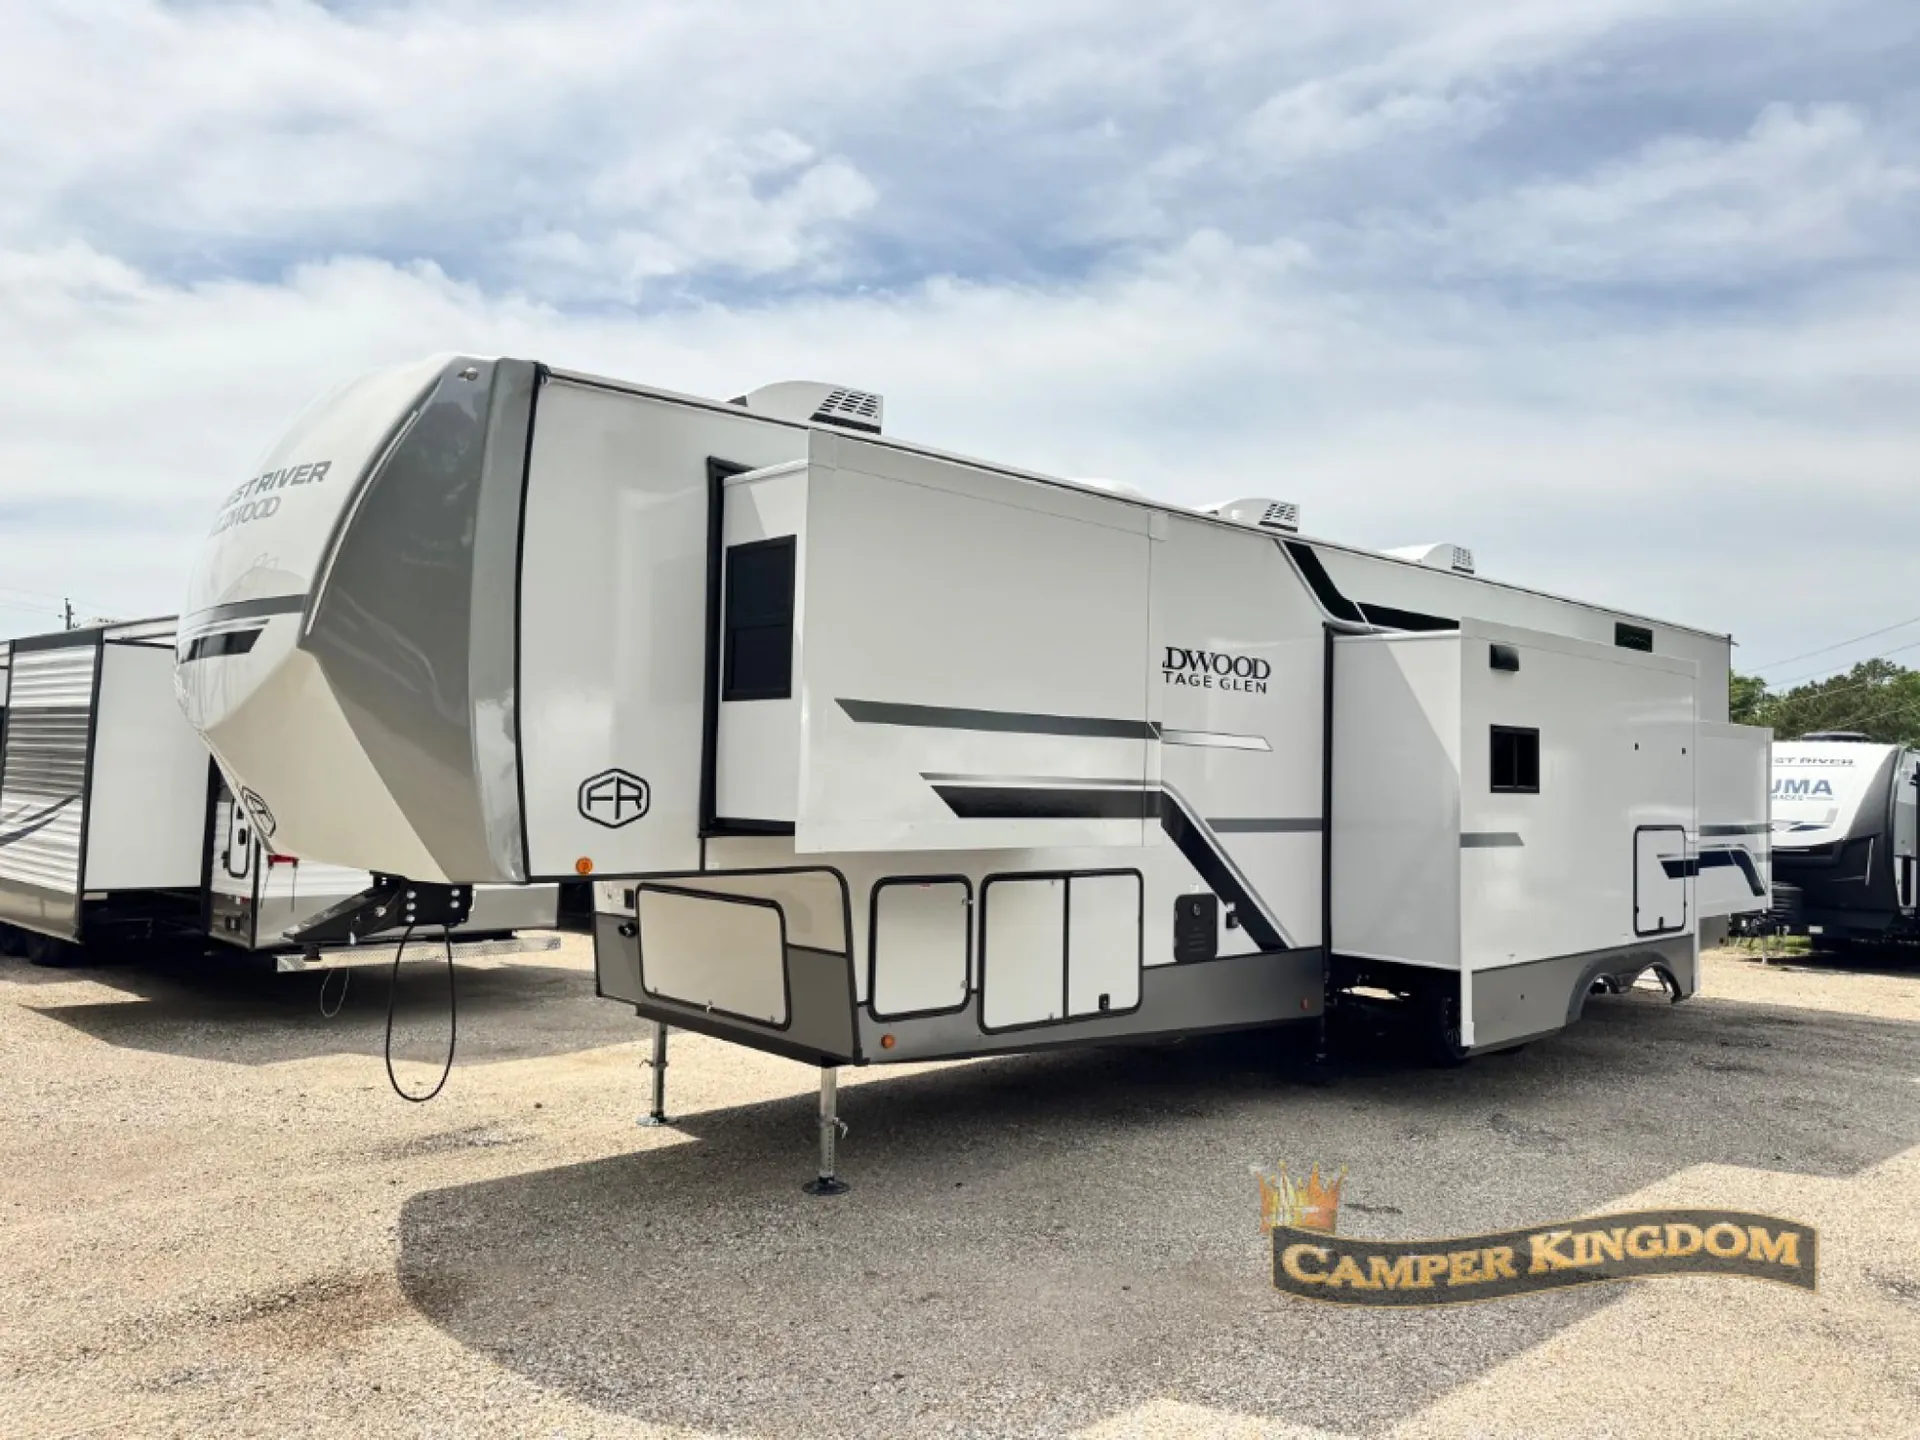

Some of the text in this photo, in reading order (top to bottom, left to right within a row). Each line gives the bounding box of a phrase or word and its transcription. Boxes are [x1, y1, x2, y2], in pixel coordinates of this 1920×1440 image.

[254, 461, 332, 495] RIVER
[1162, 646, 1271, 680] DWOOD
[1162, 670, 1267, 694] TAGE GLEN
